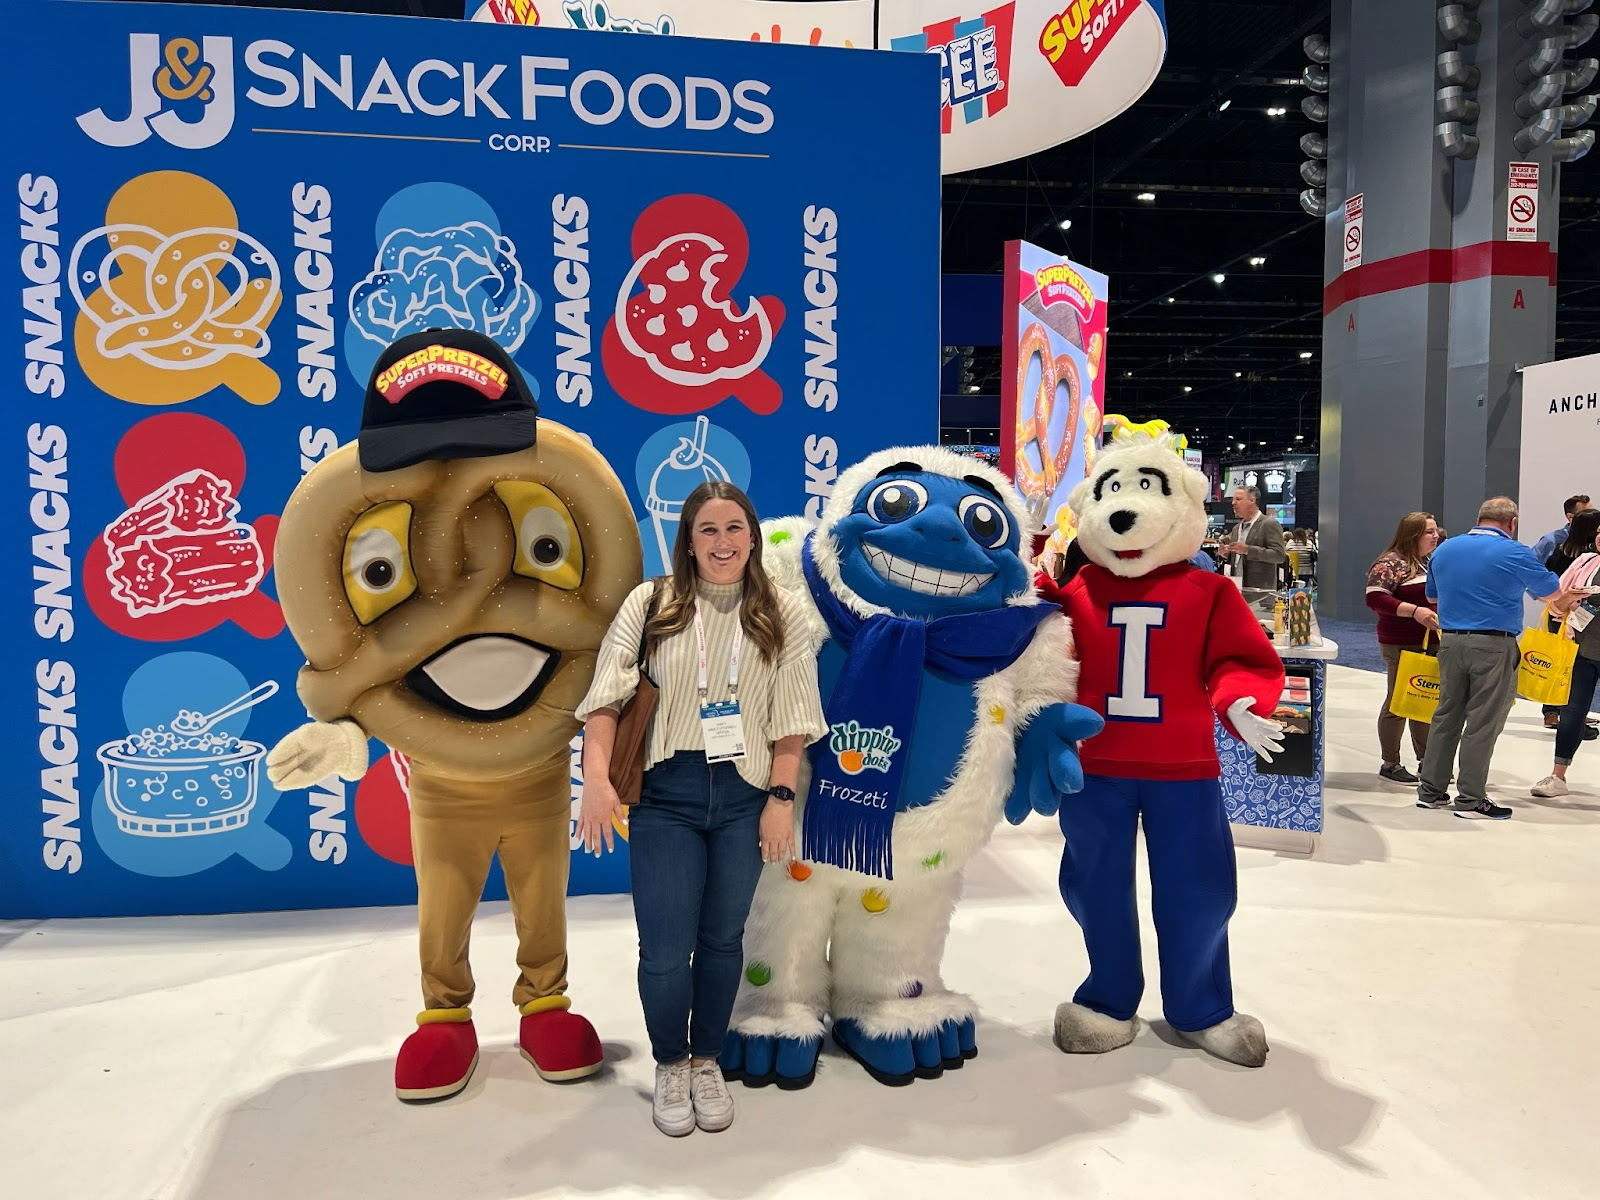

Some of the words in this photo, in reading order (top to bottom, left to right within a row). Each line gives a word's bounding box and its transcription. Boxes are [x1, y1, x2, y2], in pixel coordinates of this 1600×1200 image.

[75, 32, 236, 149] J&J
[245, 39, 510, 119] SNACK
[521, 55, 775, 134] FOODS
[488, 133, 551, 153] CORP.
[18, 173, 65, 399] SNACKS
[292, 181, 337, 402] SNACKS
[552, 193, 593, 407] SNACKS
[803, 204, 839, 412] SNACKS
[1037, 265, 1095, 309] SUPERPRETZEL
[1347, 313, 1356, 332] A
[1513, 289, 1525, 309] A
[375, 344, 509, 394] SUPERPRETZEL
[397, 366, 427, 389] SOFT
[428, 362, 488, 386] PRETZELS
[27, 423, 74, 643] SNACKS
[1106, 603, 1167, 721] I
[1415, 678, 1440, 691] Stern
[36, 659, 82, 874] SNACKS
[862, 752, 889, 770] dots
